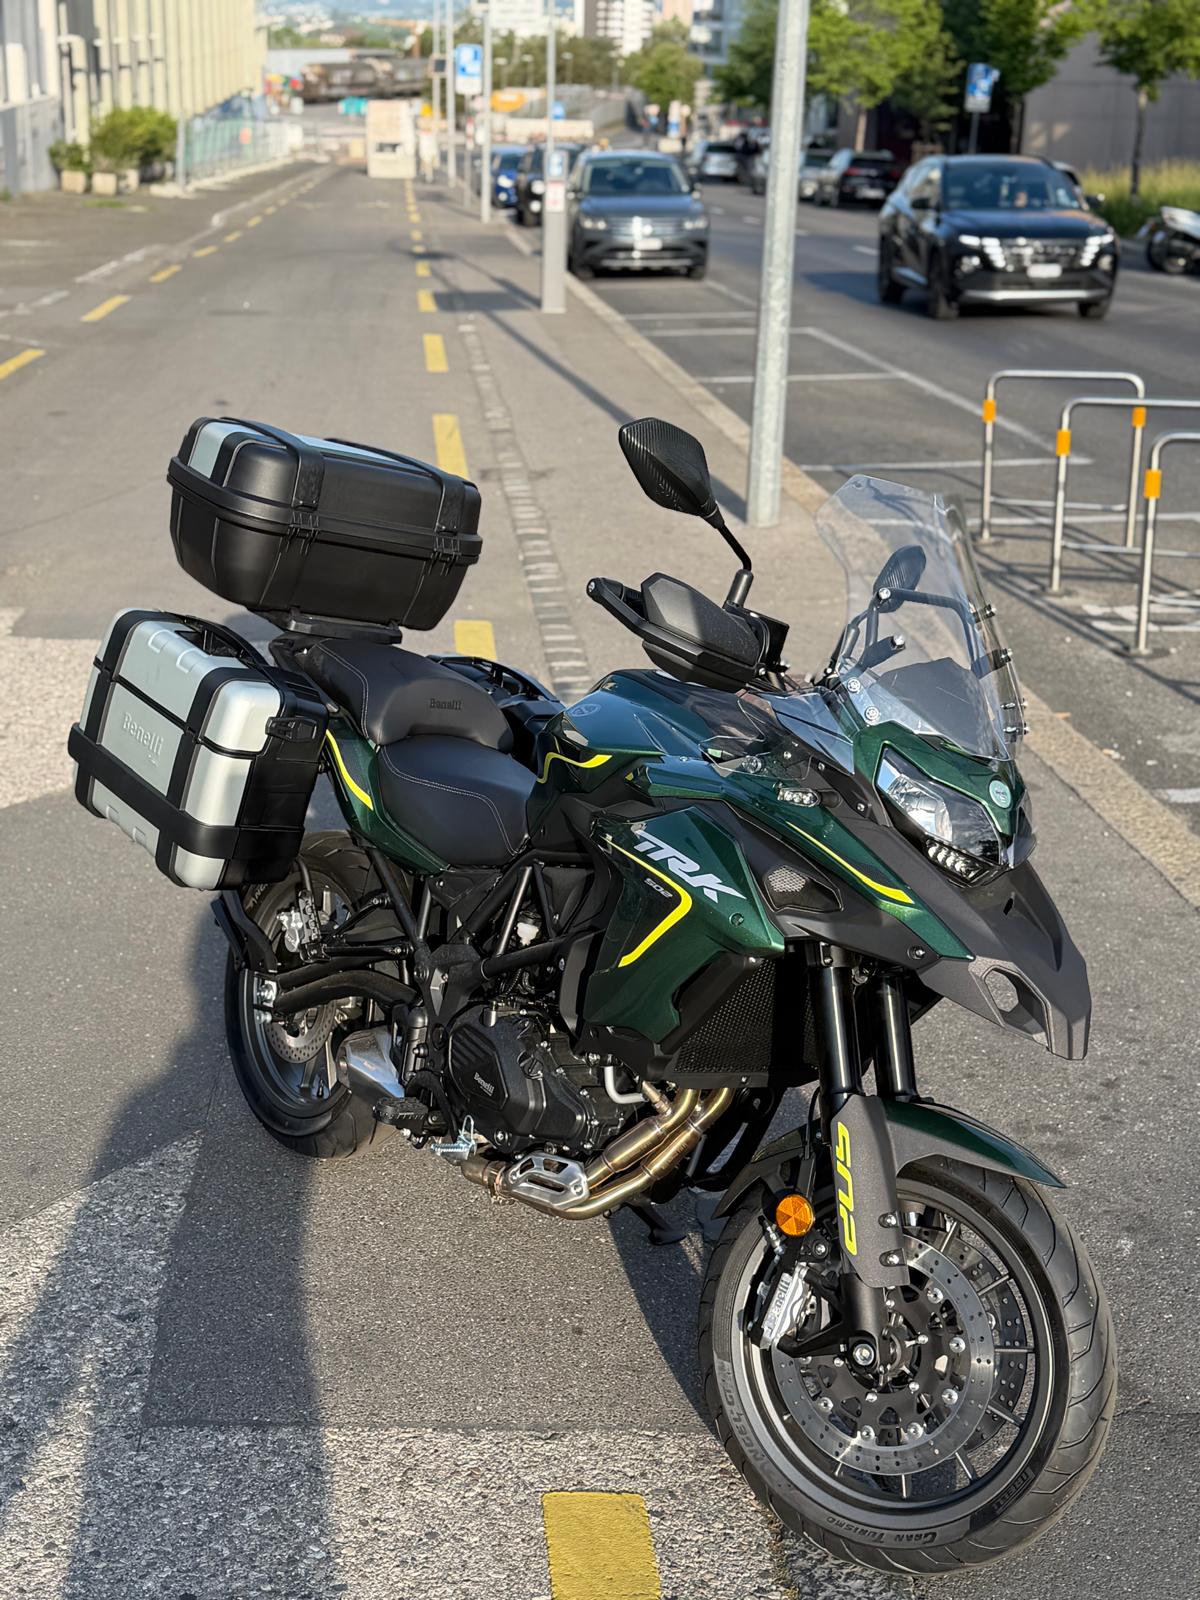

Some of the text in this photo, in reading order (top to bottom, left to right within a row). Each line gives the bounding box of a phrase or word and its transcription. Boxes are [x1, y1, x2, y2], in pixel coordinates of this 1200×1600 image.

[122, 711, 164, 756] Benelli
[633, 829, 747, 904] TRK
[643, 876, 674, 899] 502
[826, 1515, 938, 1545] GRAN TURISMO
